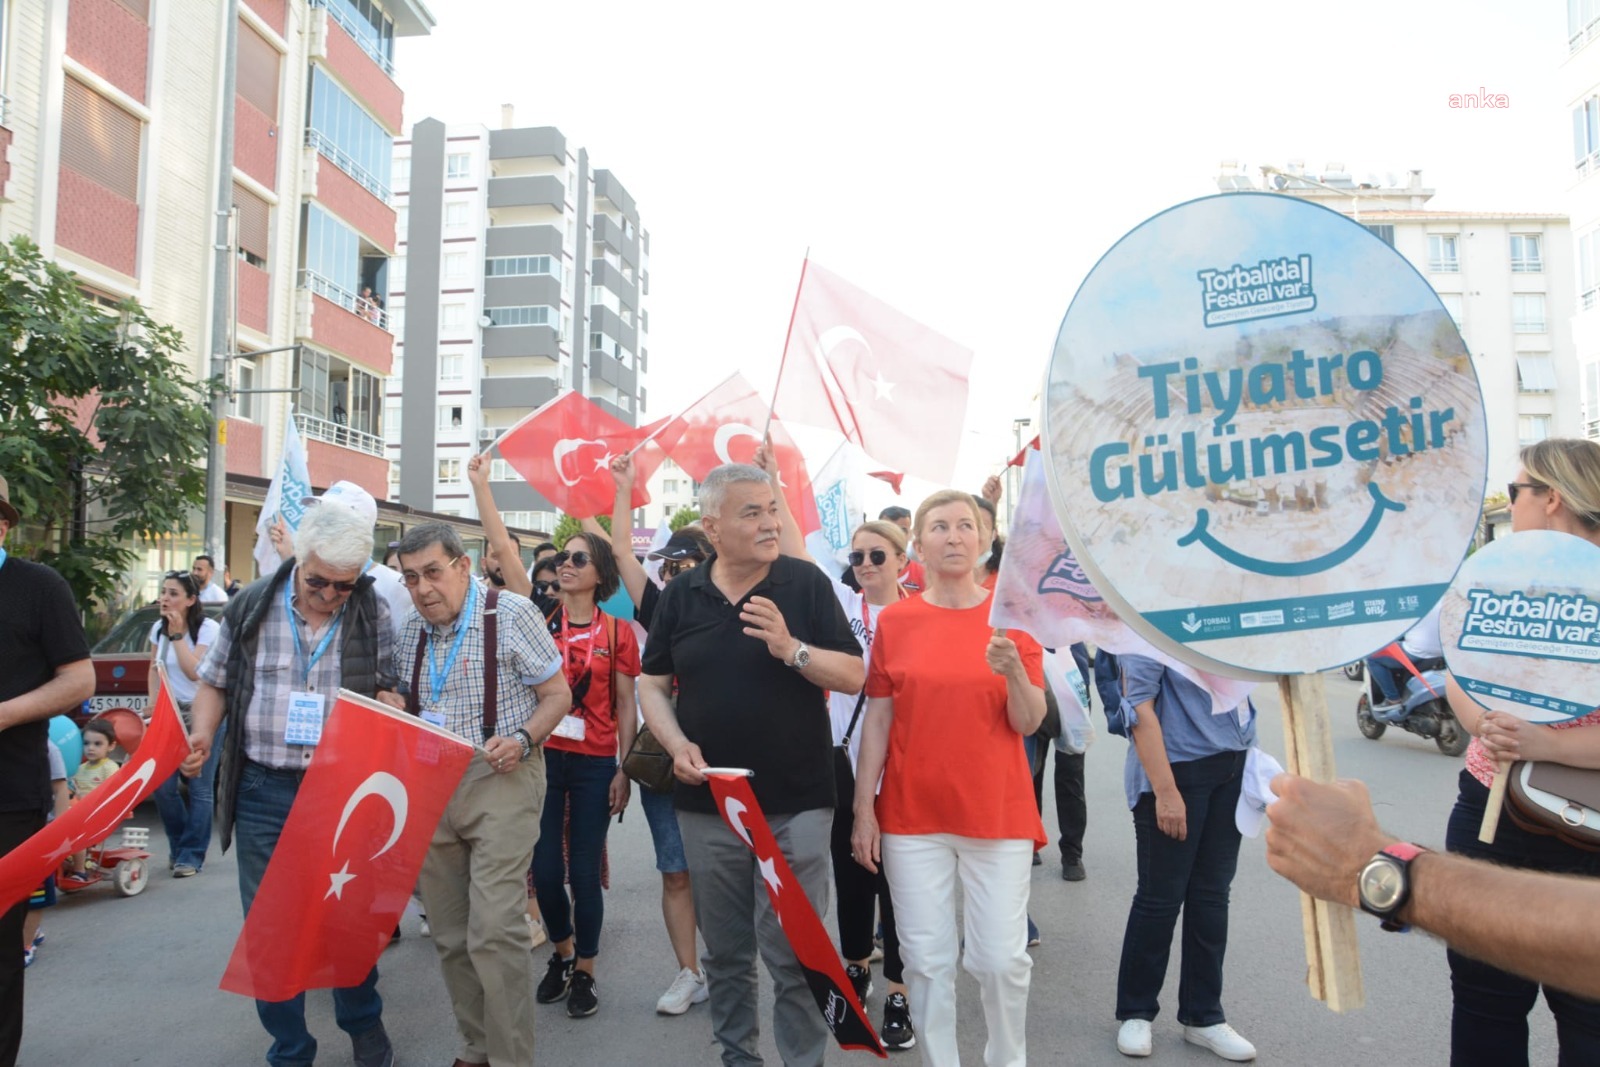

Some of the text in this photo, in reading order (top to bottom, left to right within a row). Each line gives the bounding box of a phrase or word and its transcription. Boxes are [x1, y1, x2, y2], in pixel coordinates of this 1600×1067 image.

[1205, 284, 1273, 310] Festival
[1138, 350, 1384, 428] Tiyatro
[1089, 396, 1455, 502] Gülümsetir
[1203, 616, 1231, 626] TORBALI
[1466, 614, 1553, 639] Festival
[89, 698, 104, 711] 45
